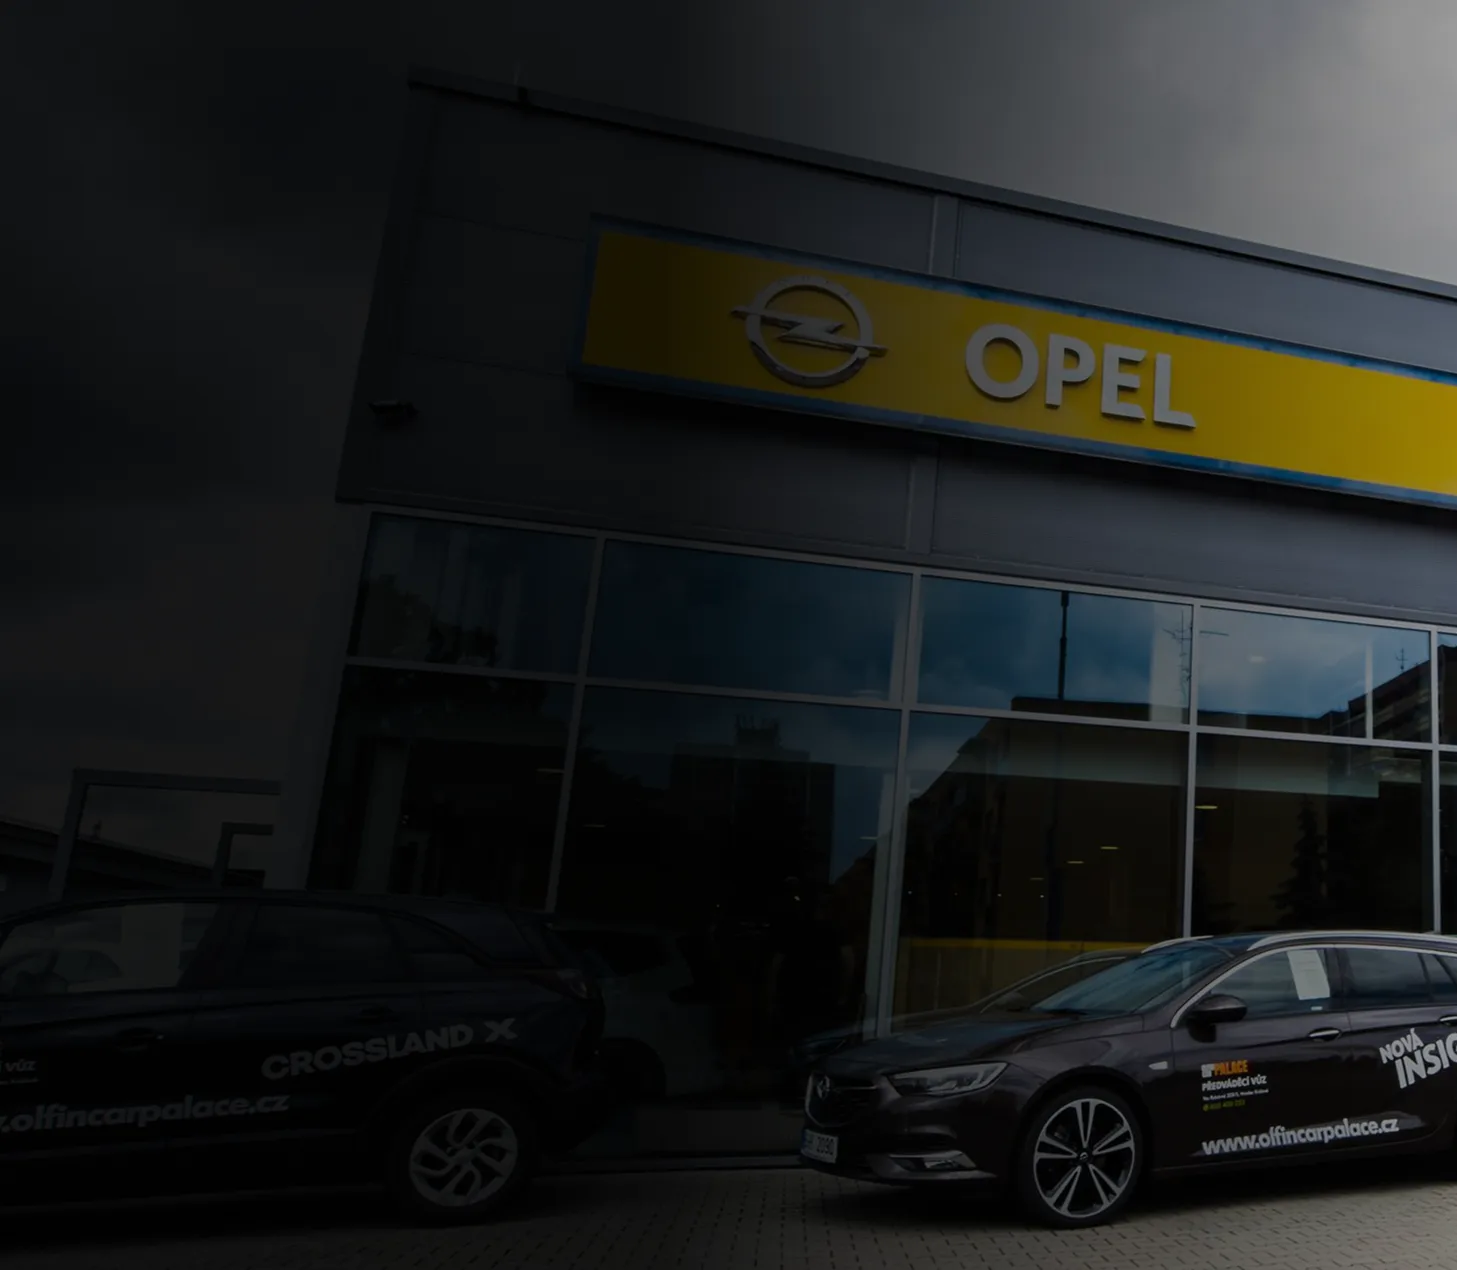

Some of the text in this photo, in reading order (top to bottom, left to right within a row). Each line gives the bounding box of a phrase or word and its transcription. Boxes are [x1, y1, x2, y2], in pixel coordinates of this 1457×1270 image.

[966, 324, 1195, 428] OPEL
[261, 1018, 518, 1080] CROSSLAND X
[1379, 1028, 1424, 1064] NOVÁ
[1201, 1117, 1400, 1156] www.olfincarpalace.cz
